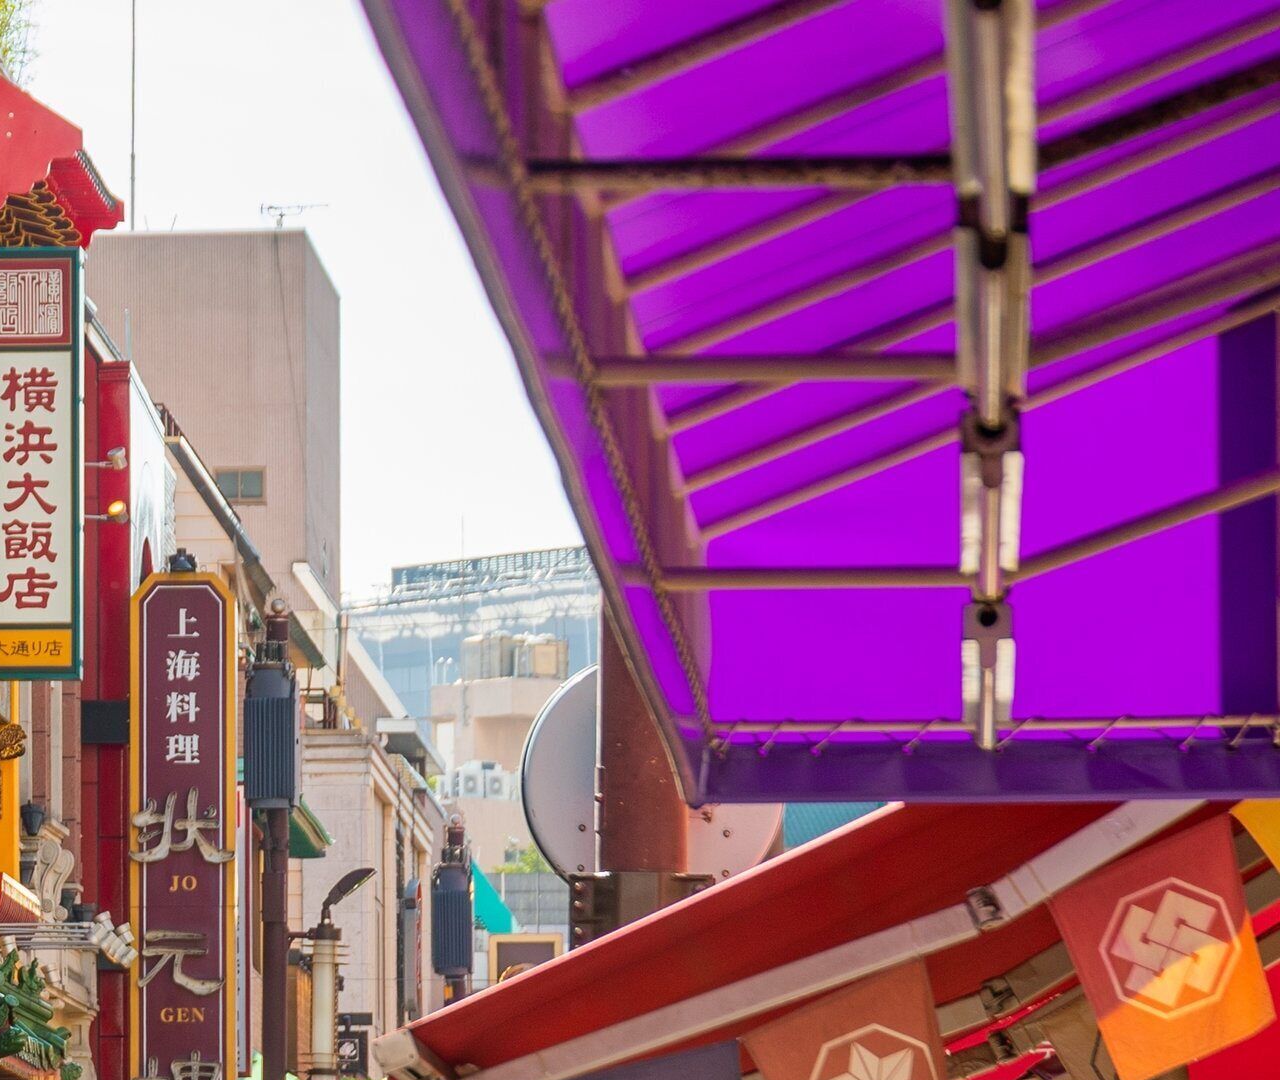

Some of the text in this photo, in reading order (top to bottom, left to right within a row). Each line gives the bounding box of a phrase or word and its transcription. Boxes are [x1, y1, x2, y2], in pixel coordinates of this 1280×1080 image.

[165, 607, 201, 765] 上海料理
[169, 875, 197, 892] JO
[160, 1006, 206, 1024] GEN
